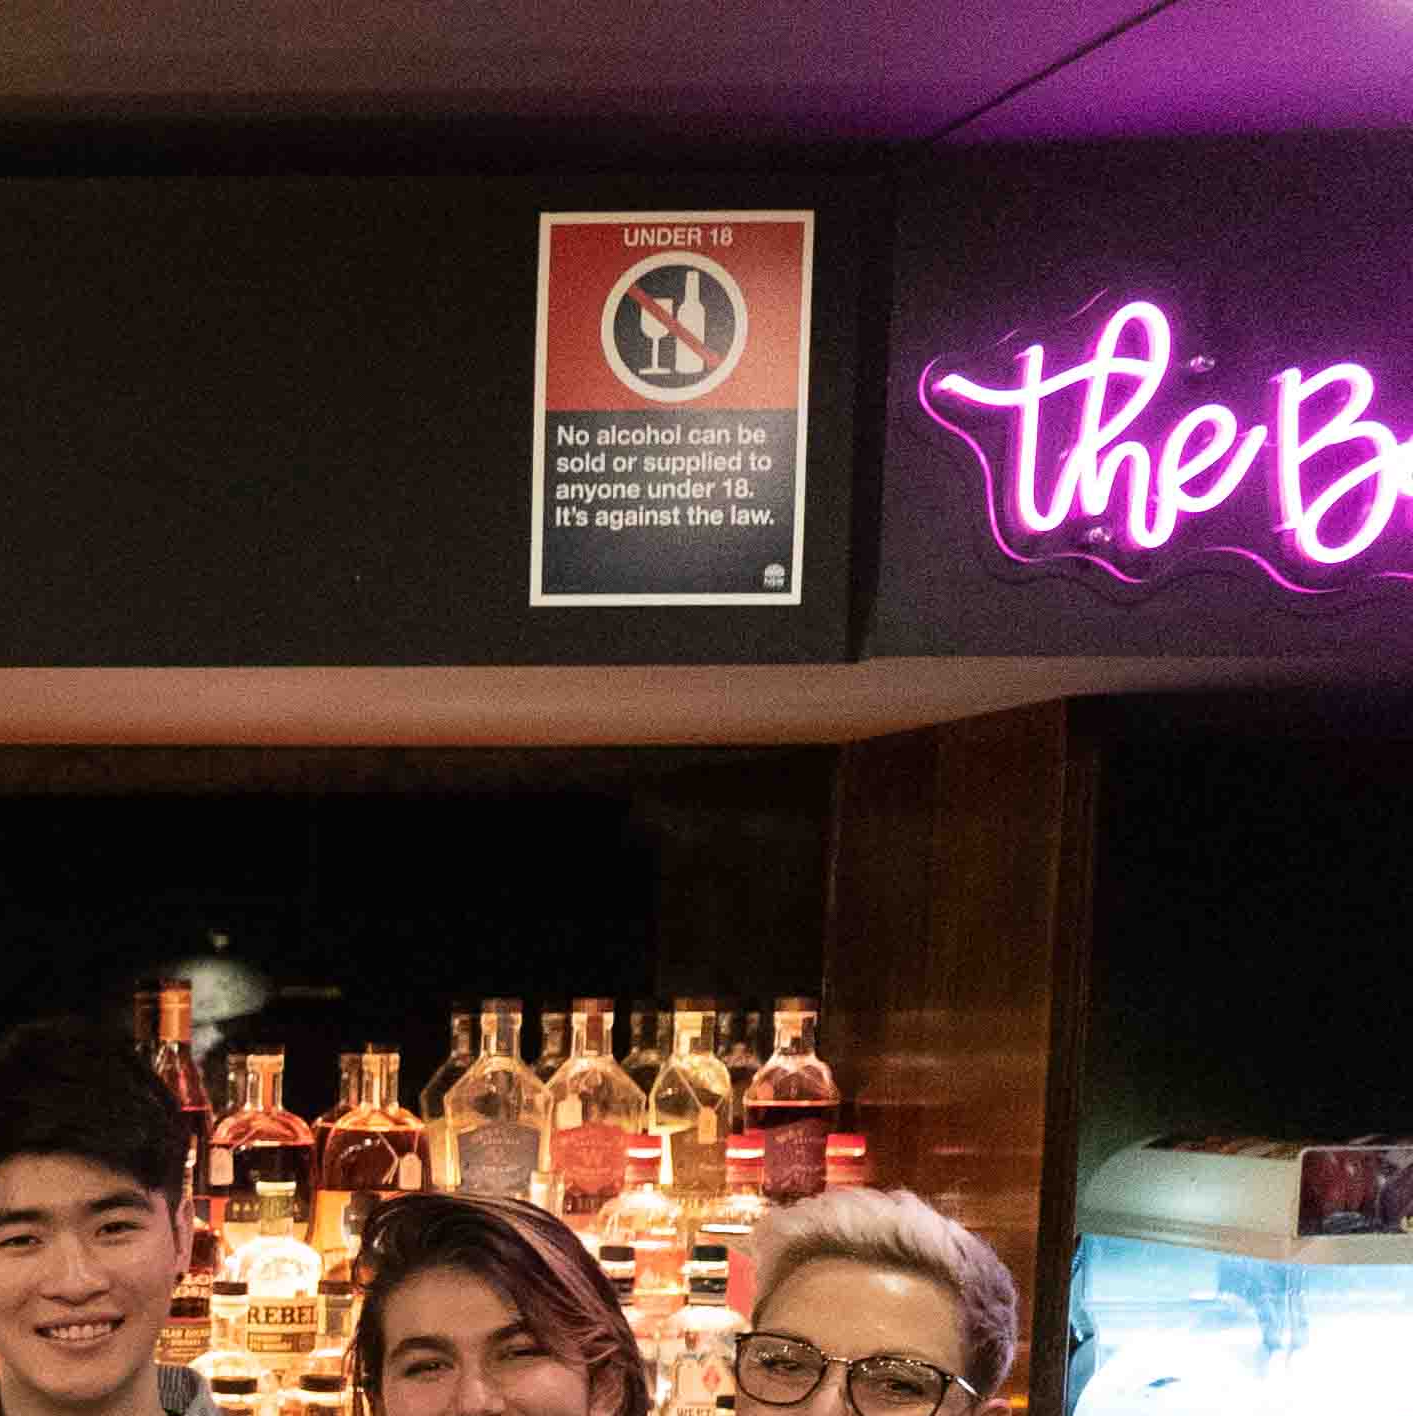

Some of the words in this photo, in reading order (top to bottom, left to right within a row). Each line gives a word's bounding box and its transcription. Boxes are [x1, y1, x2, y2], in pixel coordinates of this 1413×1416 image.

[623, 227, 702, 247] UNDER
[709, 227, 733, 246] 18
[557, 426, 590, 445] No
[596, 425, 681, 445] alcohol
[688, 429, 730, 445] can
[738, 424, 766, 444] be
[931, 301, 1268, 549] the
[1273, 362, 1413, 565] B
[556, 452, 605, 472] sold
[612, 456, 638, 472] or
[642, 451, 742, 477] supplied
[748, 452, 773, 472] to
[556, 484, 641, 504] anyone
[648, 479, 716, 499] under
[721, 479, 755, 499] 18.
[555, 507, 588, 527] It's
[594, 507, 681, 531] against
[686, 505, 724, 526] the
[730, 505, 775, 526] law.
